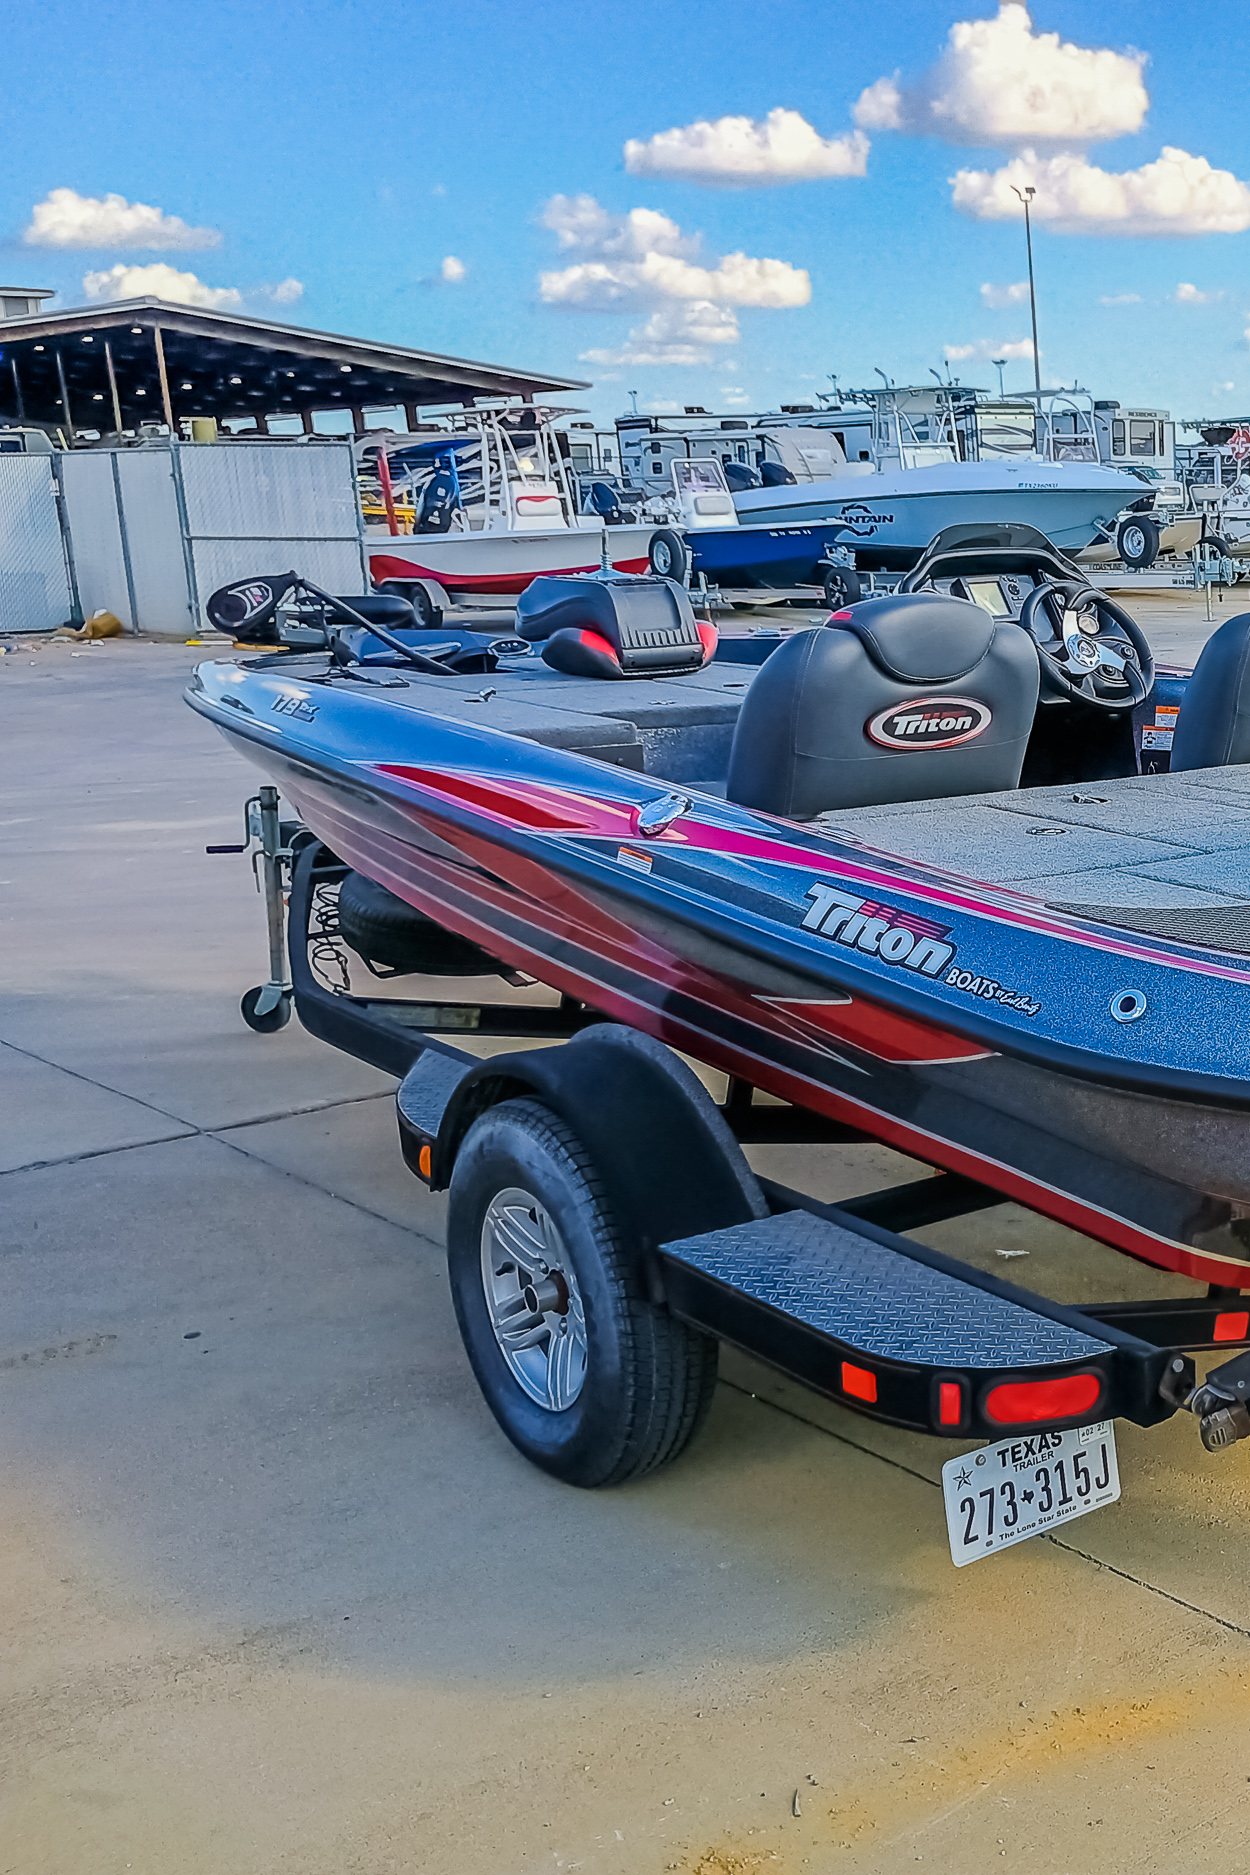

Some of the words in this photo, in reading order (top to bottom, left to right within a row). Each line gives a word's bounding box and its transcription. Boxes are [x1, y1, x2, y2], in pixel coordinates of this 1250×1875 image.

[893, 714, 973, 736] Triton
[801, 881, 954, 977] Triton
[945, 967, 999, 998] BOATS
[997, 1431, 1063, 1468] TEXAS
[1013, 1450, 1055, 1473] TRAILER
[999, 1531, 1015, 1541] The
[1017, 1521, 1036, 1533] Lone
[1038, 1513, 1055, 1524] Star
[1056, 1505, 1077, 1517] State
